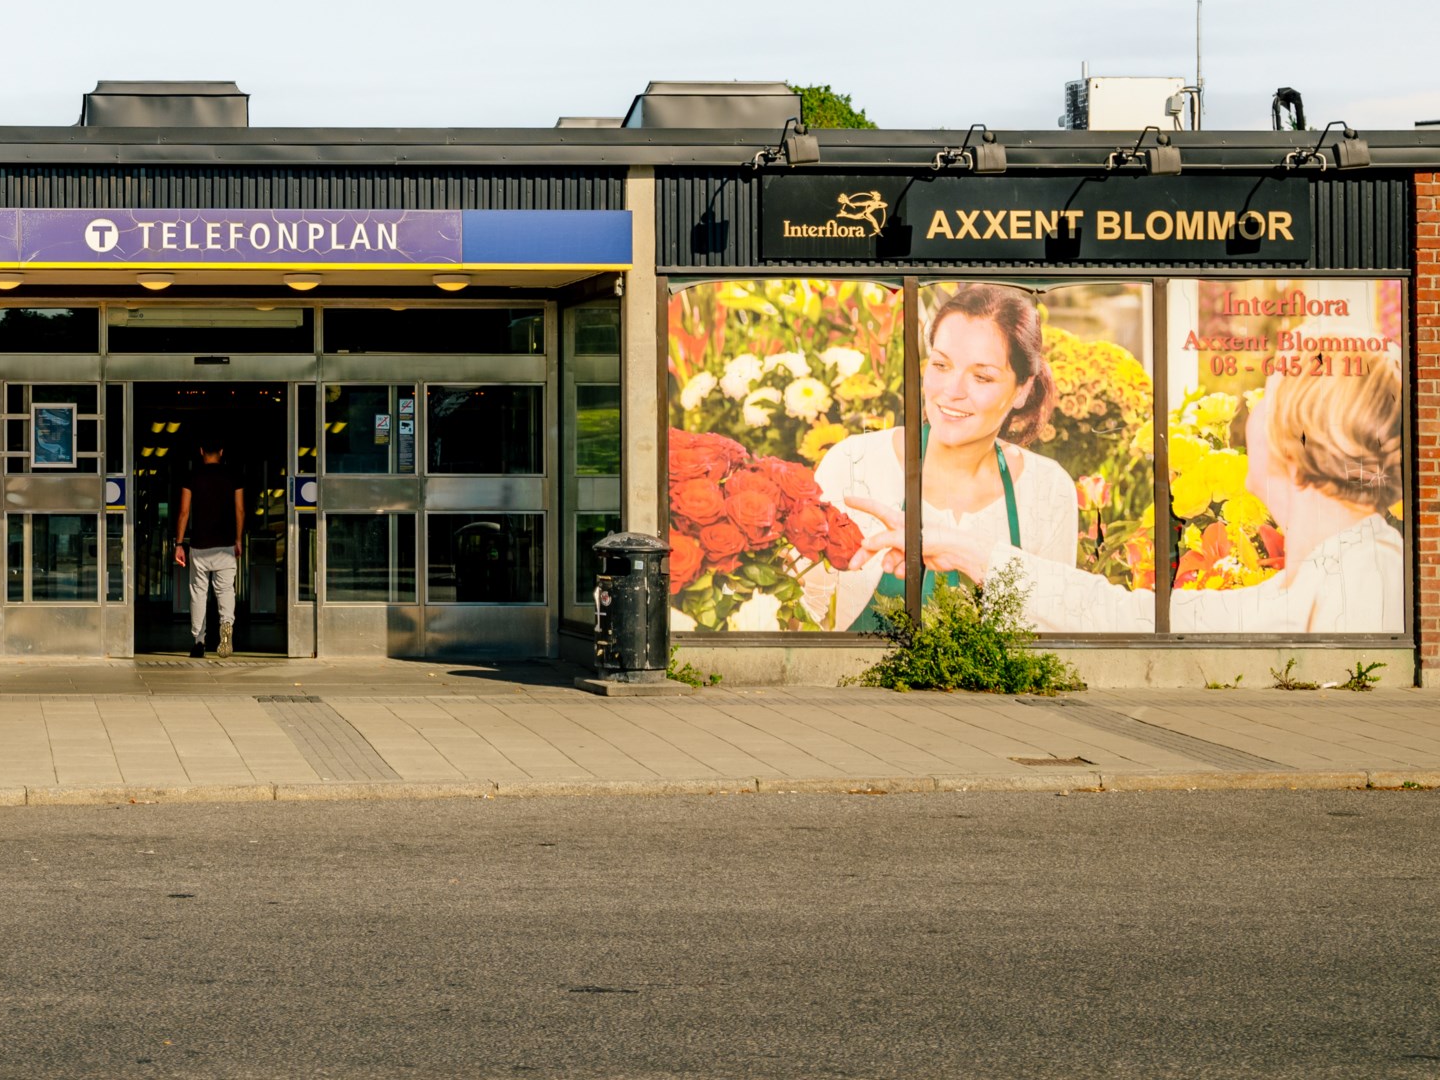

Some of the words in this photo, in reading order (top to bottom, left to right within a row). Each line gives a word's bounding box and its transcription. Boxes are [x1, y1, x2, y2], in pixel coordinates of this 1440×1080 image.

[138, 222, 397, 250] TELEFONPLAN
[783, 220, 866, 237] Interflora
[926, 210, 1084, 240] AXXENT
[1096, 210, 1295, 241] BLOMMOR
[1223, 289, 1349, 317] Interflora
[1183, 330, 1268, 351] Axxent
[1277, 331, 1392, 353] Blommor
[1210, 354, 1238, 377] 08
[1261, 354, 1302, 377] 645
[1310, 354, 1332, 377] 21
[1342, 354, 1364, 377] 11
